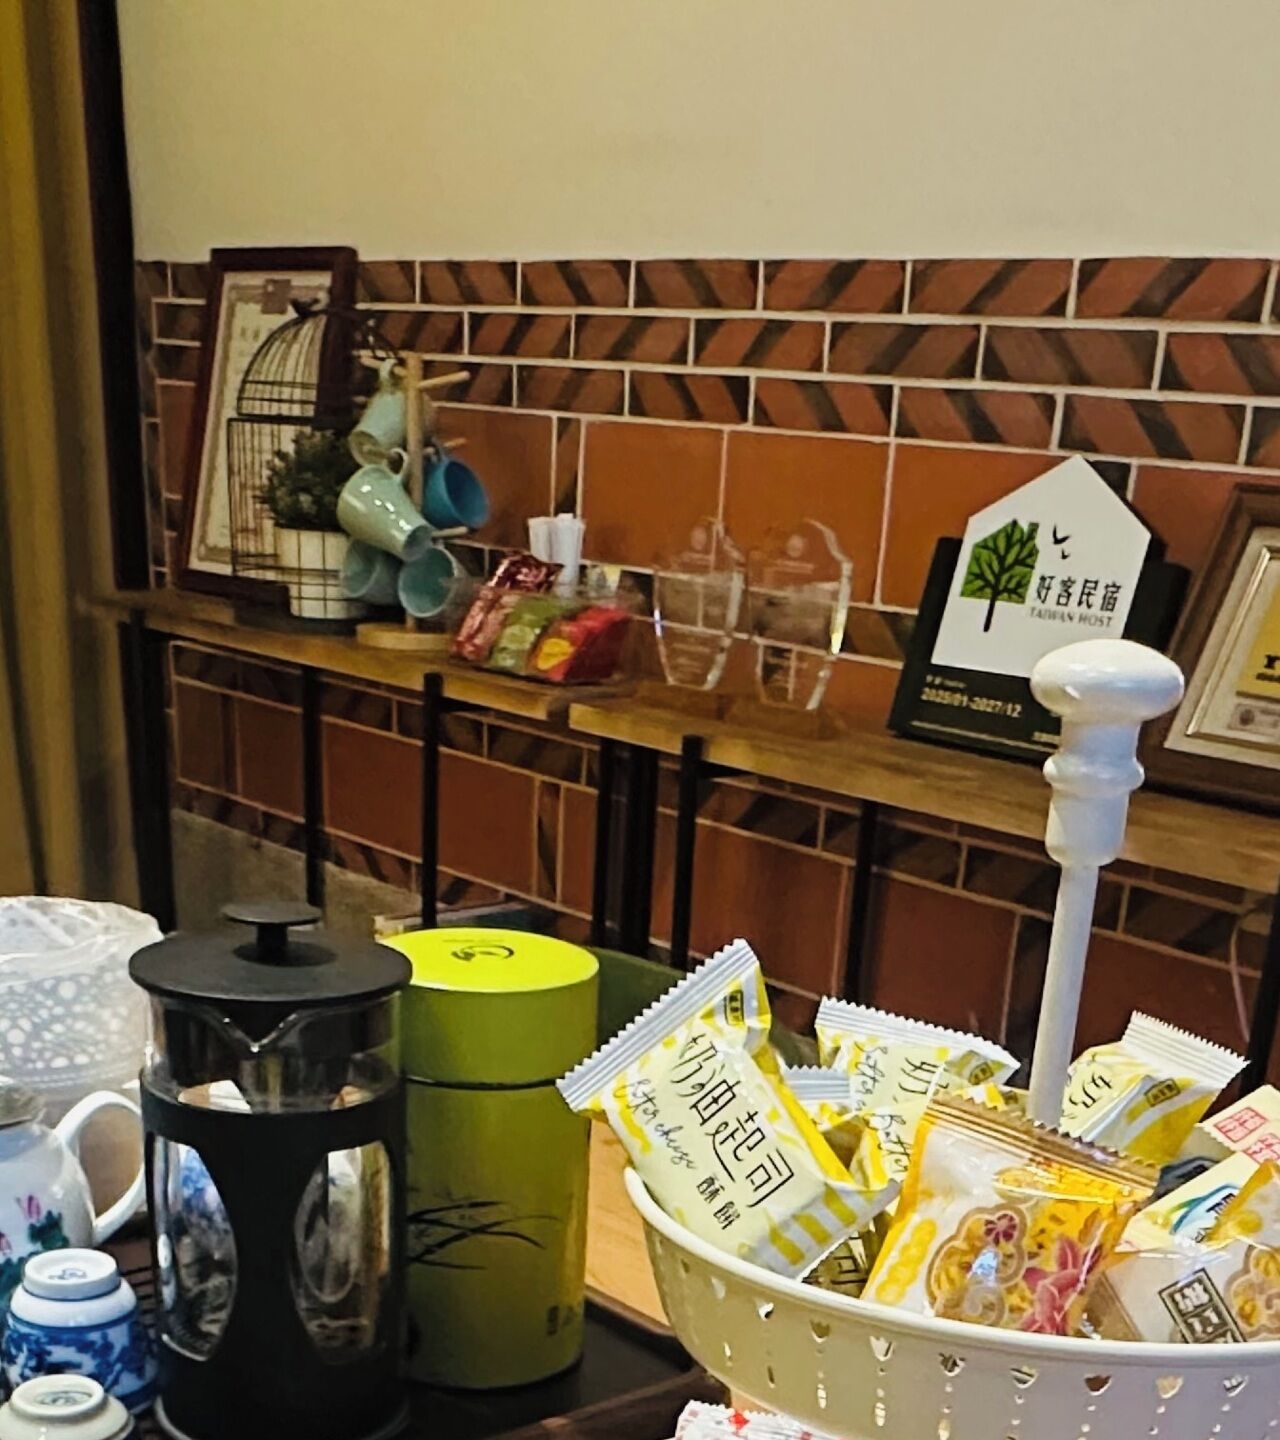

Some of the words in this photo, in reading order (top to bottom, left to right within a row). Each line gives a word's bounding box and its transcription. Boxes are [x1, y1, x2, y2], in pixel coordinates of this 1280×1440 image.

[1036, 574, 1122, 612] 好客民宿
[1078, 612, 1113, 628] HOST
[670, 1032, 795, 1208] 奶油起司
